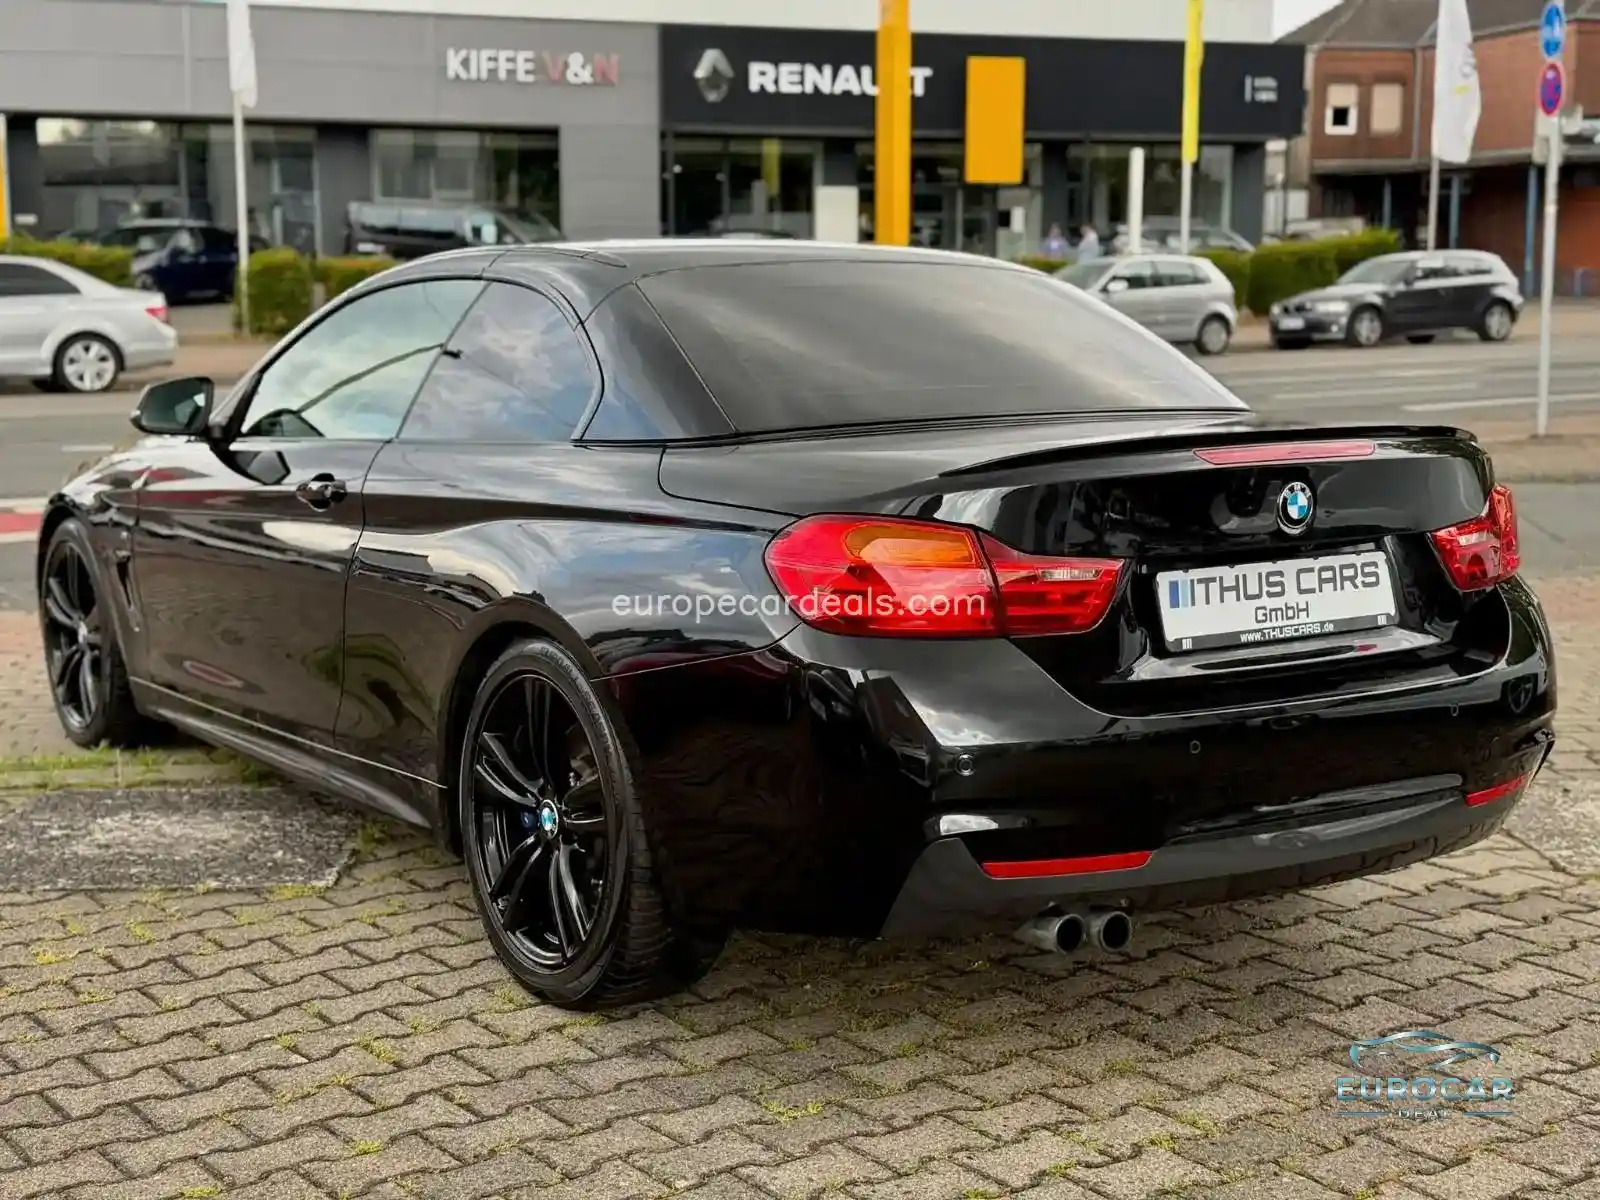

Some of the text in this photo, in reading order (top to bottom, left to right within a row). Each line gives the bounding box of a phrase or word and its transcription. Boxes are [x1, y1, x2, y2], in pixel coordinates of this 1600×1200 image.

[446, 47, 536, 83] KIFFE
[747, 61, 934, 97] RENAUT
[1296, 561, 1381, 596] CARS
[1254, 601, 1310, 625] GmbH
[1239, 622, 1335, 644] www.THUSCARS.de
